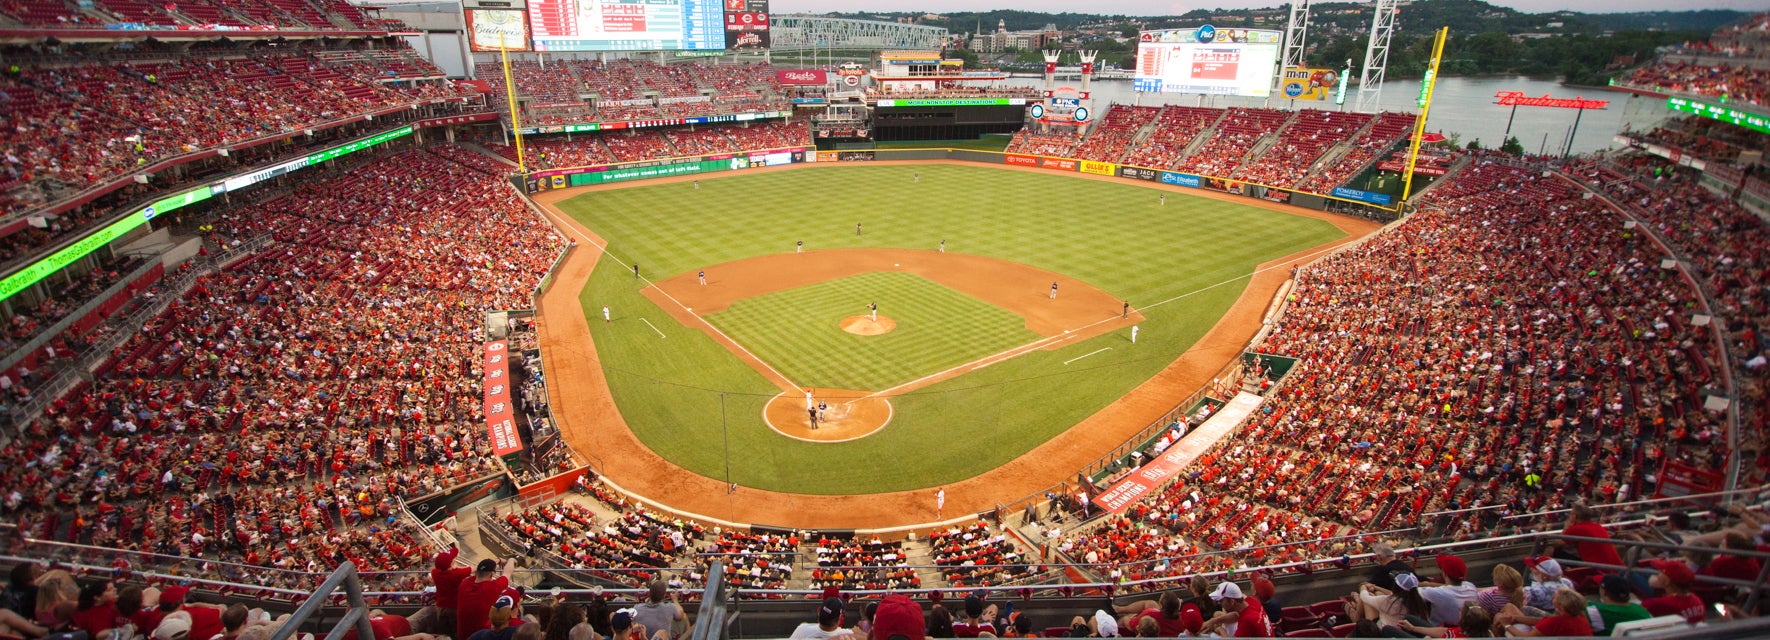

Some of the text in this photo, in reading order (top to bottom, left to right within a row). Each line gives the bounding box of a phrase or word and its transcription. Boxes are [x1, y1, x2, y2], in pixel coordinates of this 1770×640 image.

[785, 71, 817, 80] Reds
[614, 171, 639, 179] whatever
[1139, 169, 1155, 177] JACK
[1336, 187, 1365, 196] POMEROY
[0, 230, 113, 295] Galbraith ThomasGalbraith.com
[1101, 480, 1136, 503] WORLD SERIES
[1107, 483, 1147, 510] CHAMPIONS
